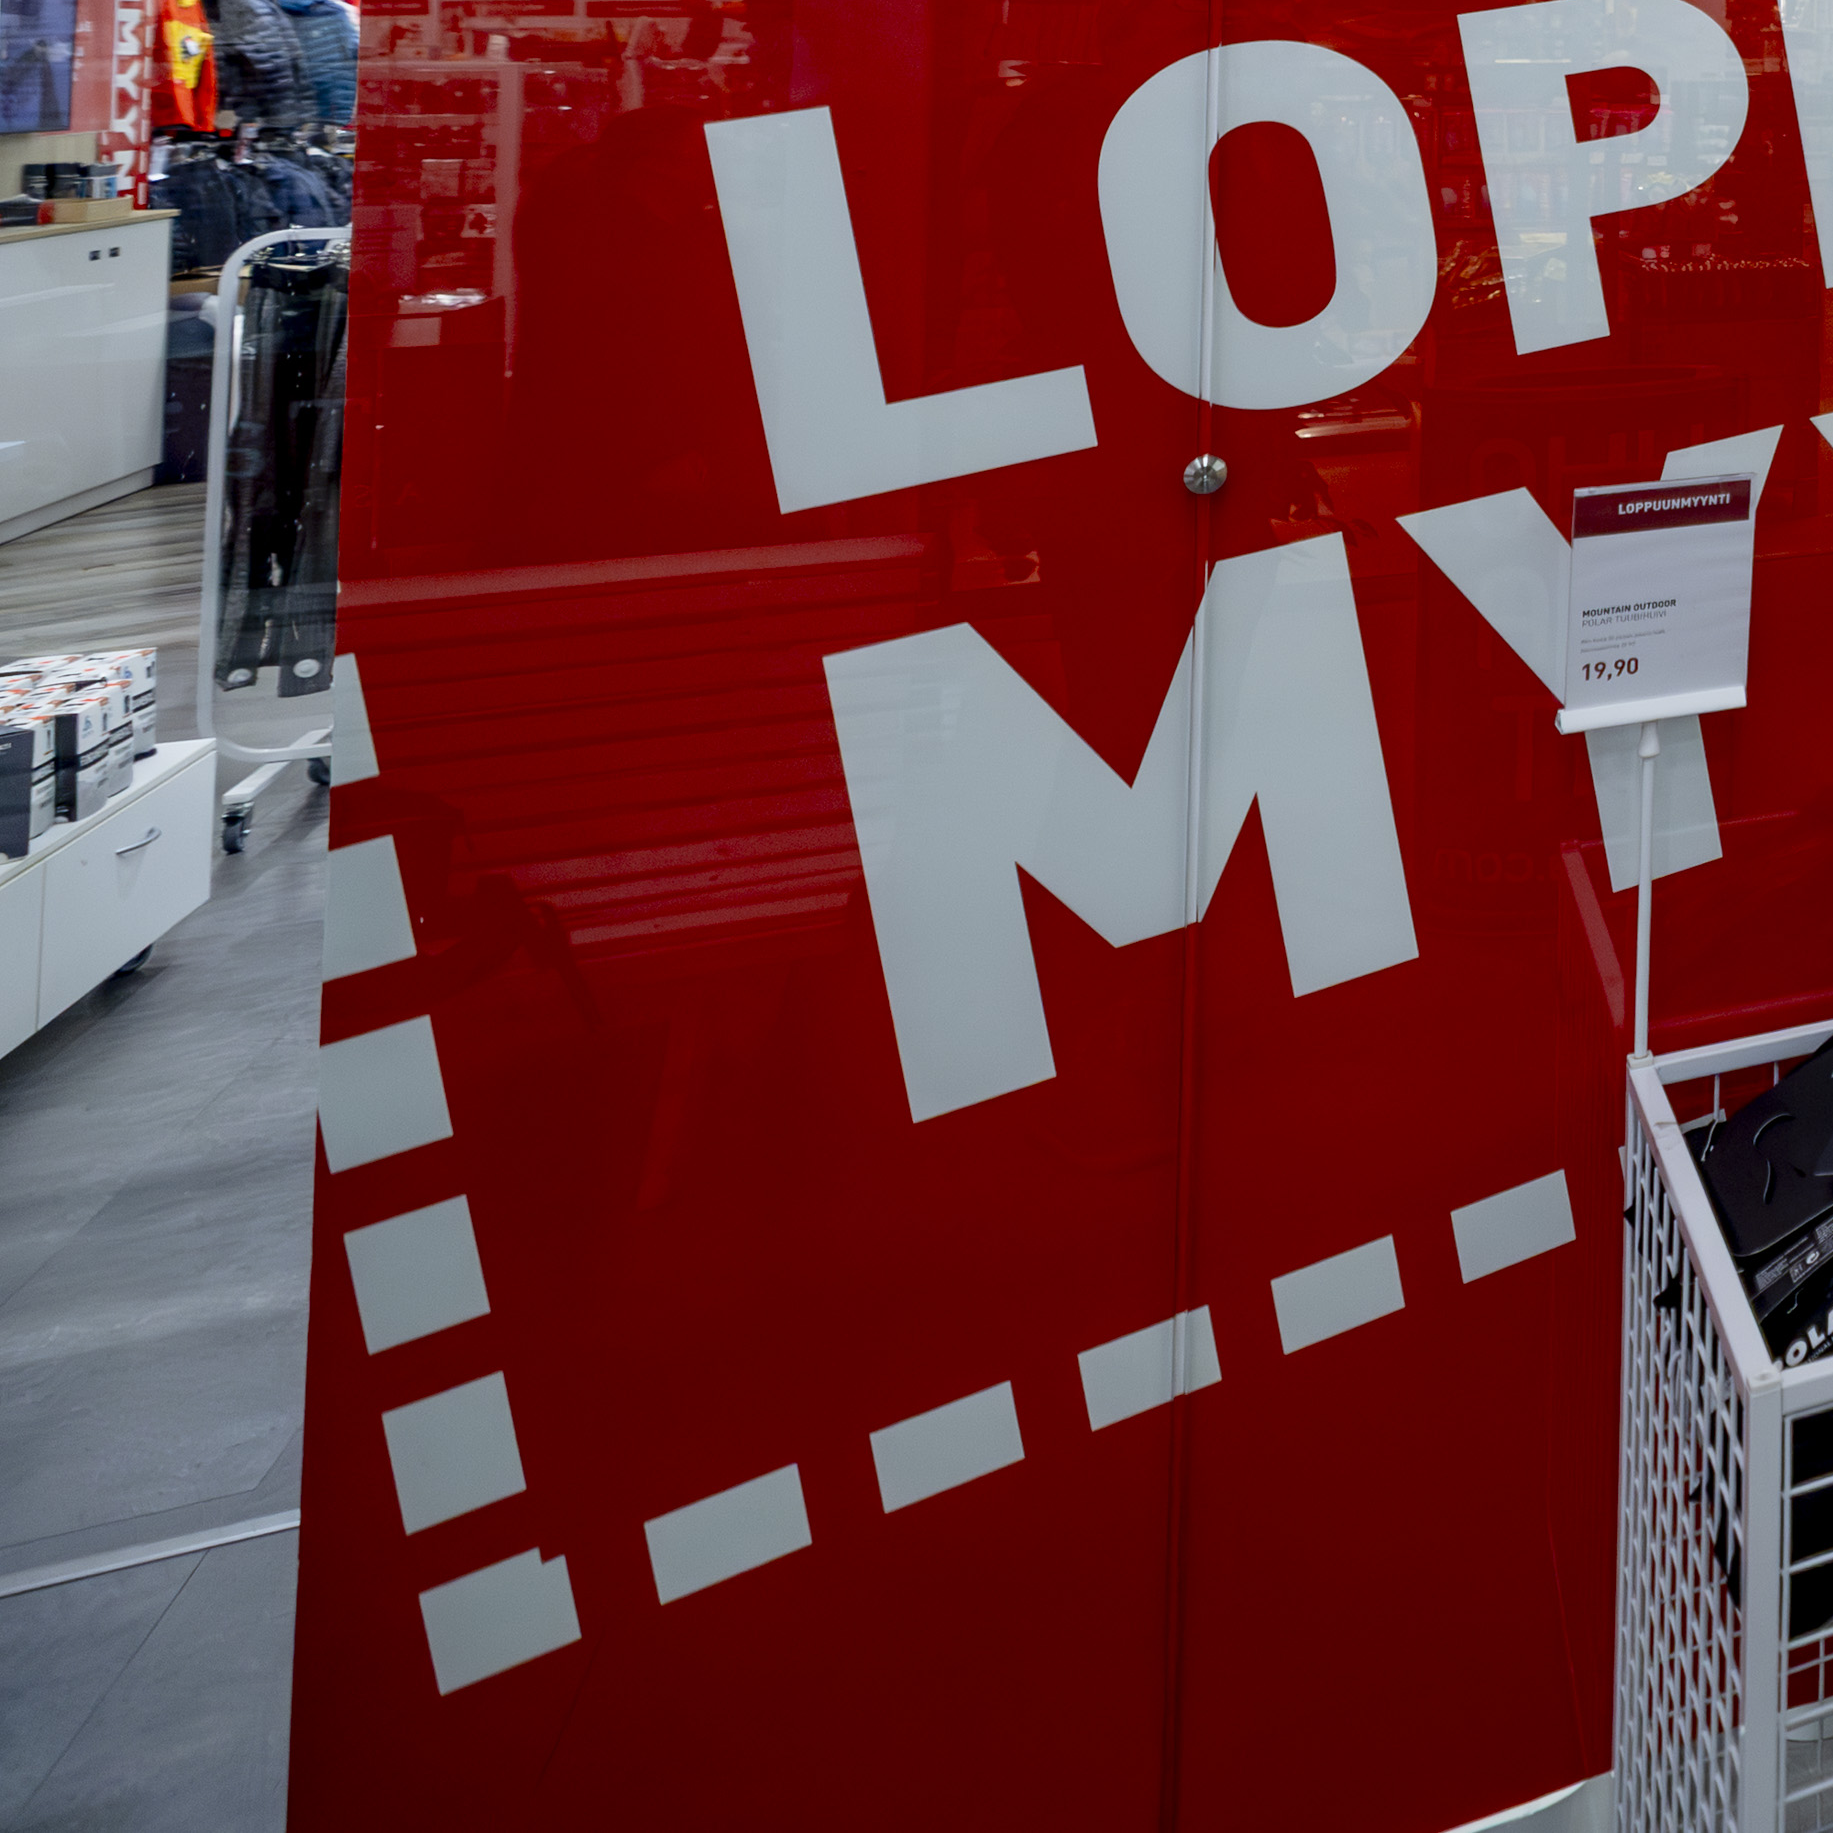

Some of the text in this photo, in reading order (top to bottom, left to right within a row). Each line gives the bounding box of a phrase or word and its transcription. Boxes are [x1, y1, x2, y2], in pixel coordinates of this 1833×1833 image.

[1617, 493, 1731, 516] LOPPUUNMYYNTI
[1581, 610, 1668, 629] POLAR TUUBIHUIVI
[1582, 598, 1677, 619] MOUNTAIN OUTDOOR
[1581, 657, 1640, 682] 19,90
